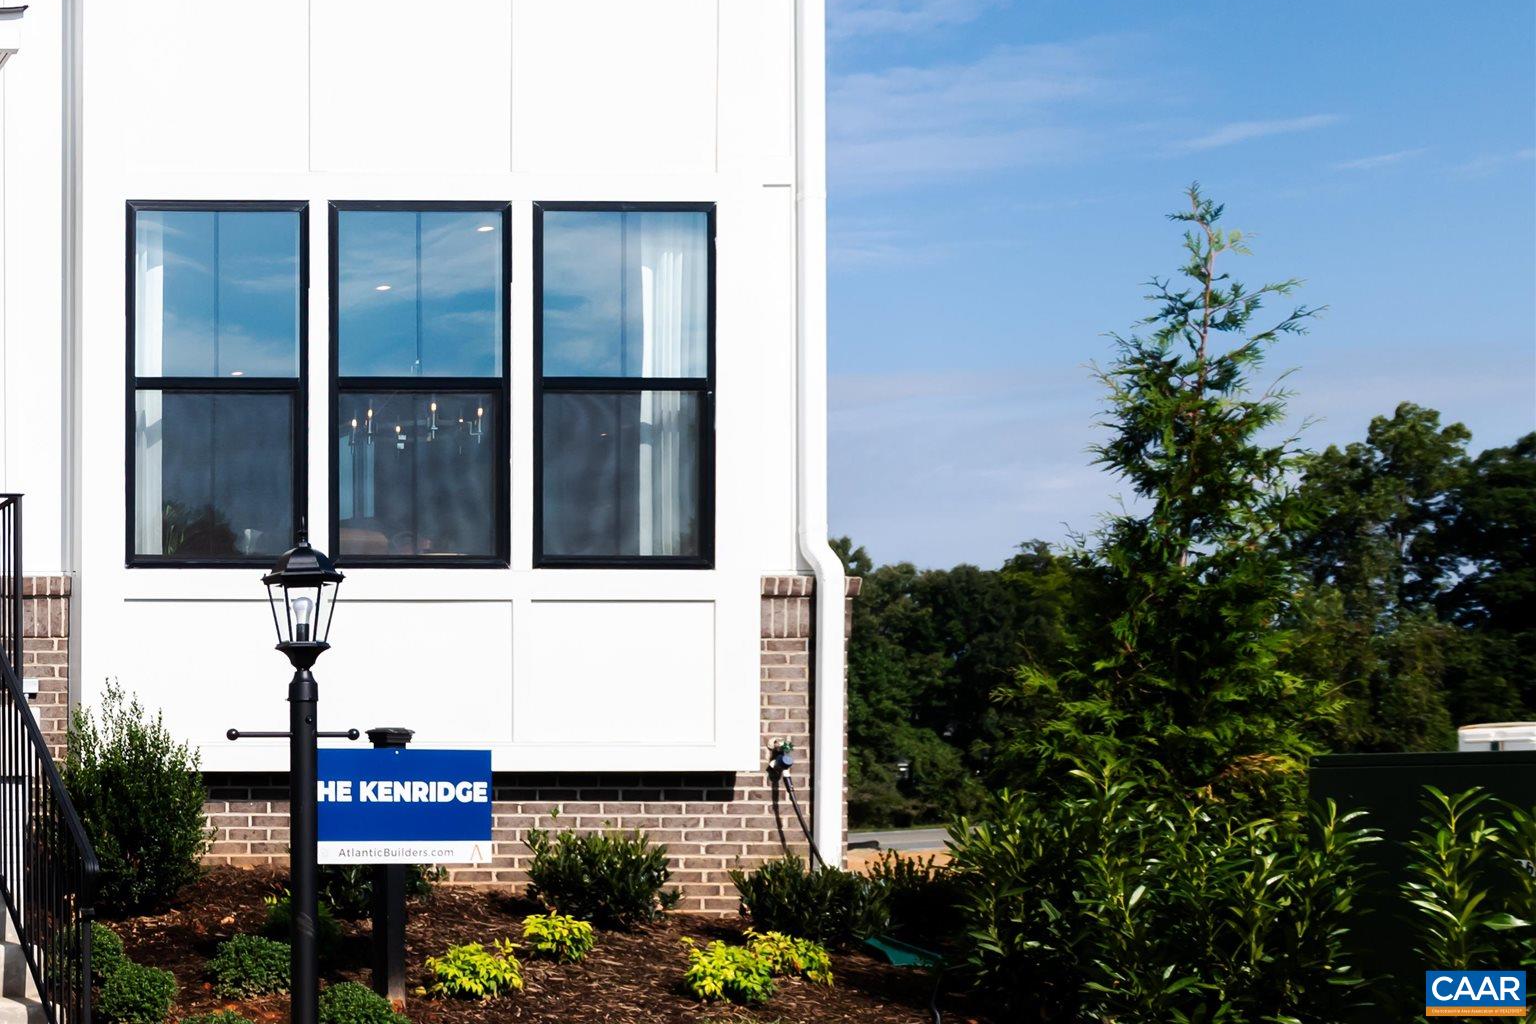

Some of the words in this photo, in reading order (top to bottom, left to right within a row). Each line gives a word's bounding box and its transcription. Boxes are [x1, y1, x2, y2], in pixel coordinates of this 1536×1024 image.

[317, 781, 353, 802] HE
[359, 781, 488, 803] KENRIDGE
[338, 848, 454, 858] AtlanticBuilders.com
